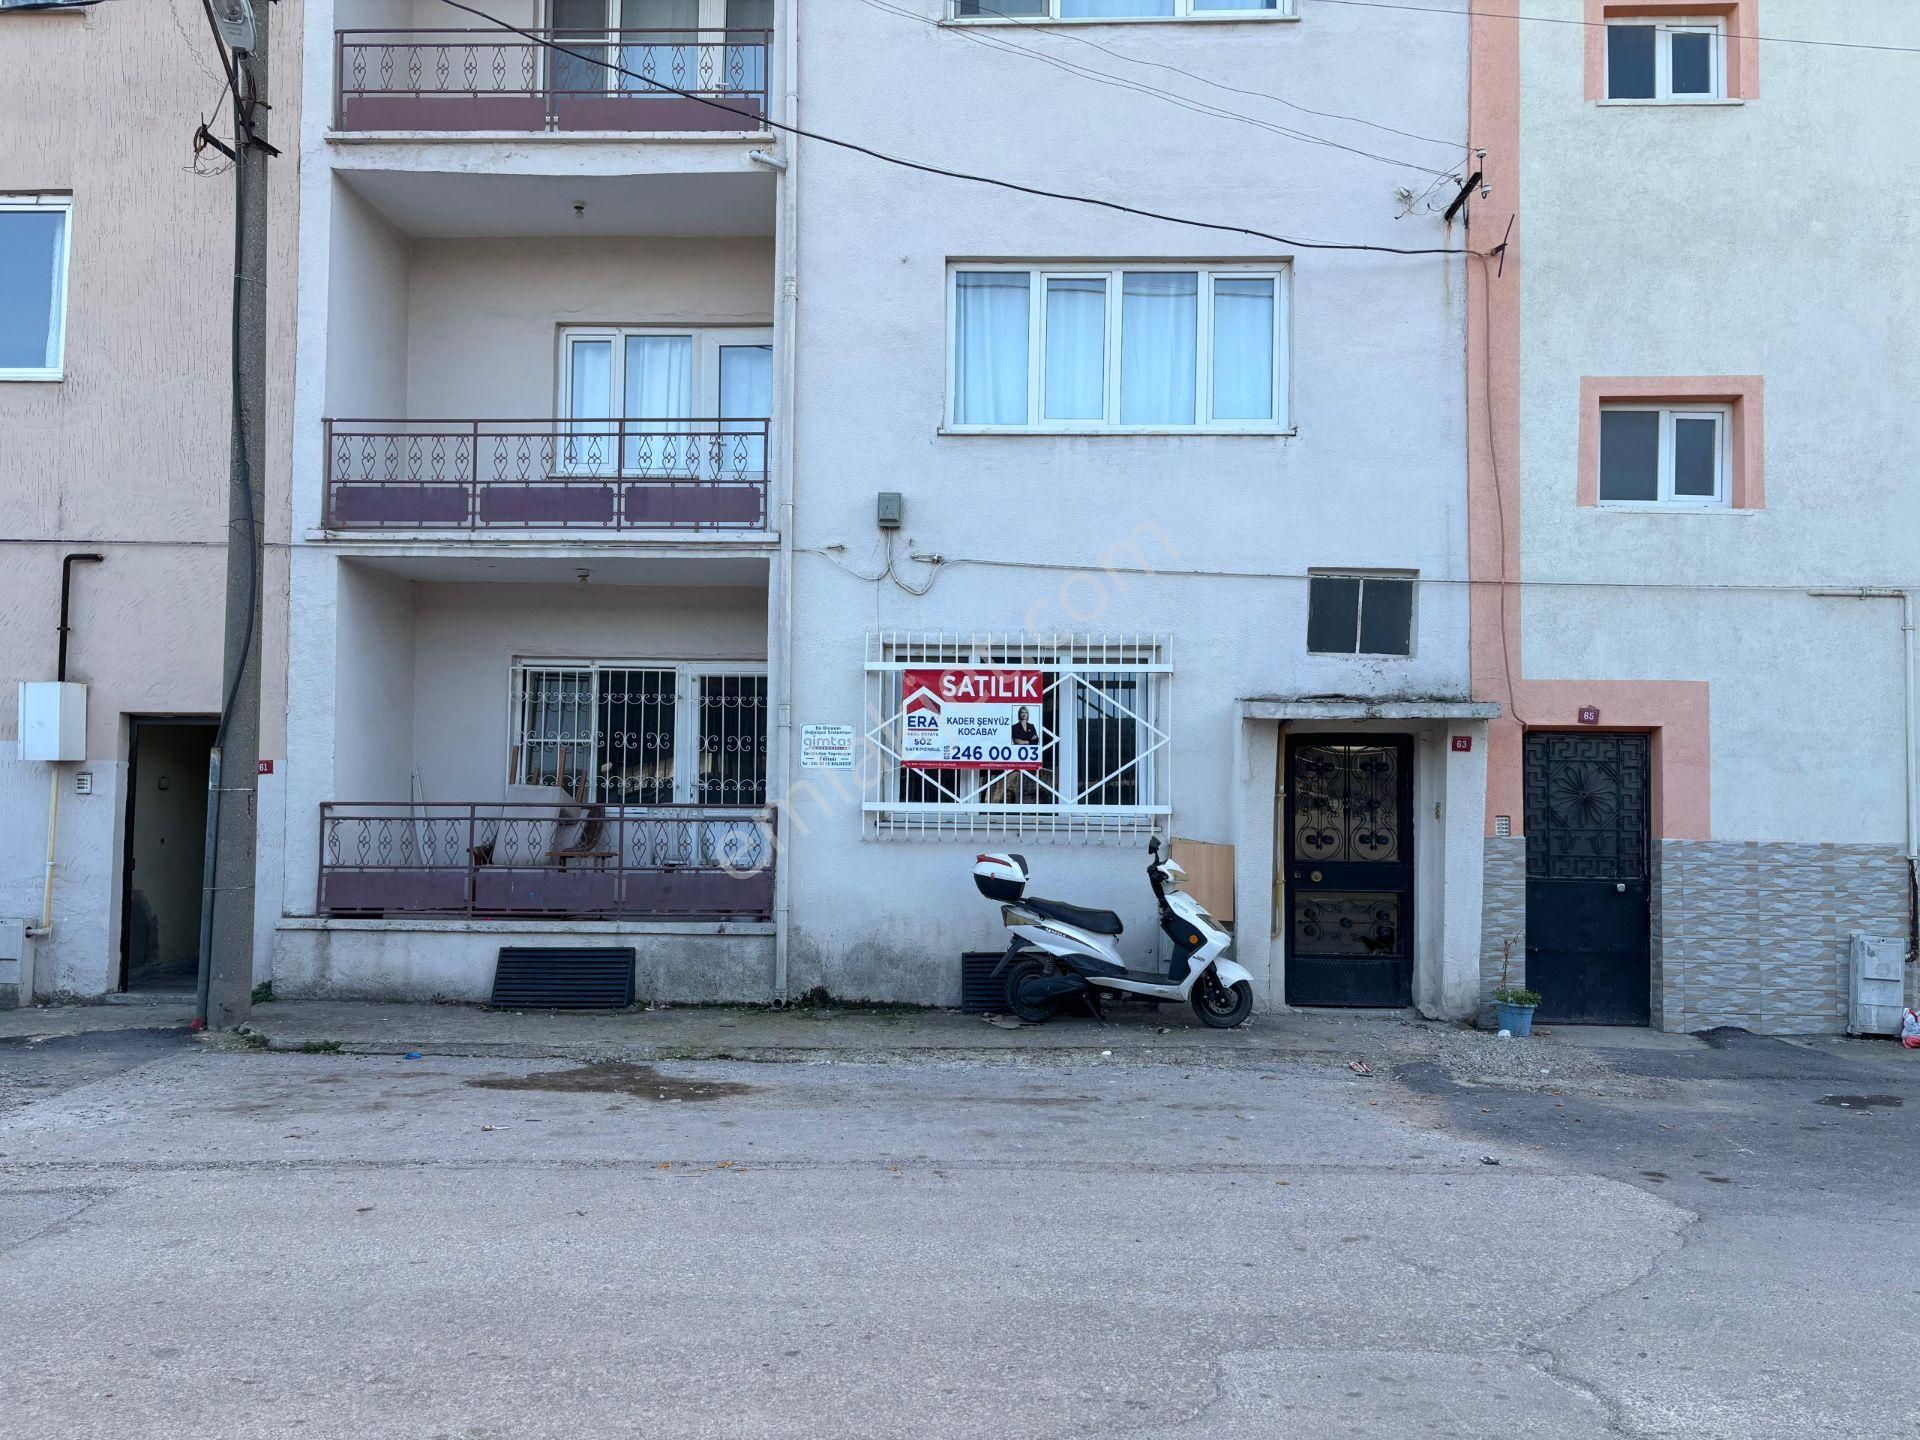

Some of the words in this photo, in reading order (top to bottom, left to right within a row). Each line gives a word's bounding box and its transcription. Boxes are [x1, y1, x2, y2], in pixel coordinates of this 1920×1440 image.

[943, 675, 1038, 697] SATILIK
[1583, 711, 1595, 720] 65
[907, 716, 938, 728] ERA
[946, 717, 975, 725] KADER
[977, 715, 1010, 727] ŞENYÜZ
[958, 728, 998, 736] KOCABAY
[914, 737, 932, 746] SÖZ
[1456, 739, 1467, 748] 63
[951, 745, 983, 760] 246
[988, 745, 1012, 761] 00
[1017, 746, 1039, 761] 03
[259, 763, 268, 771] 61
